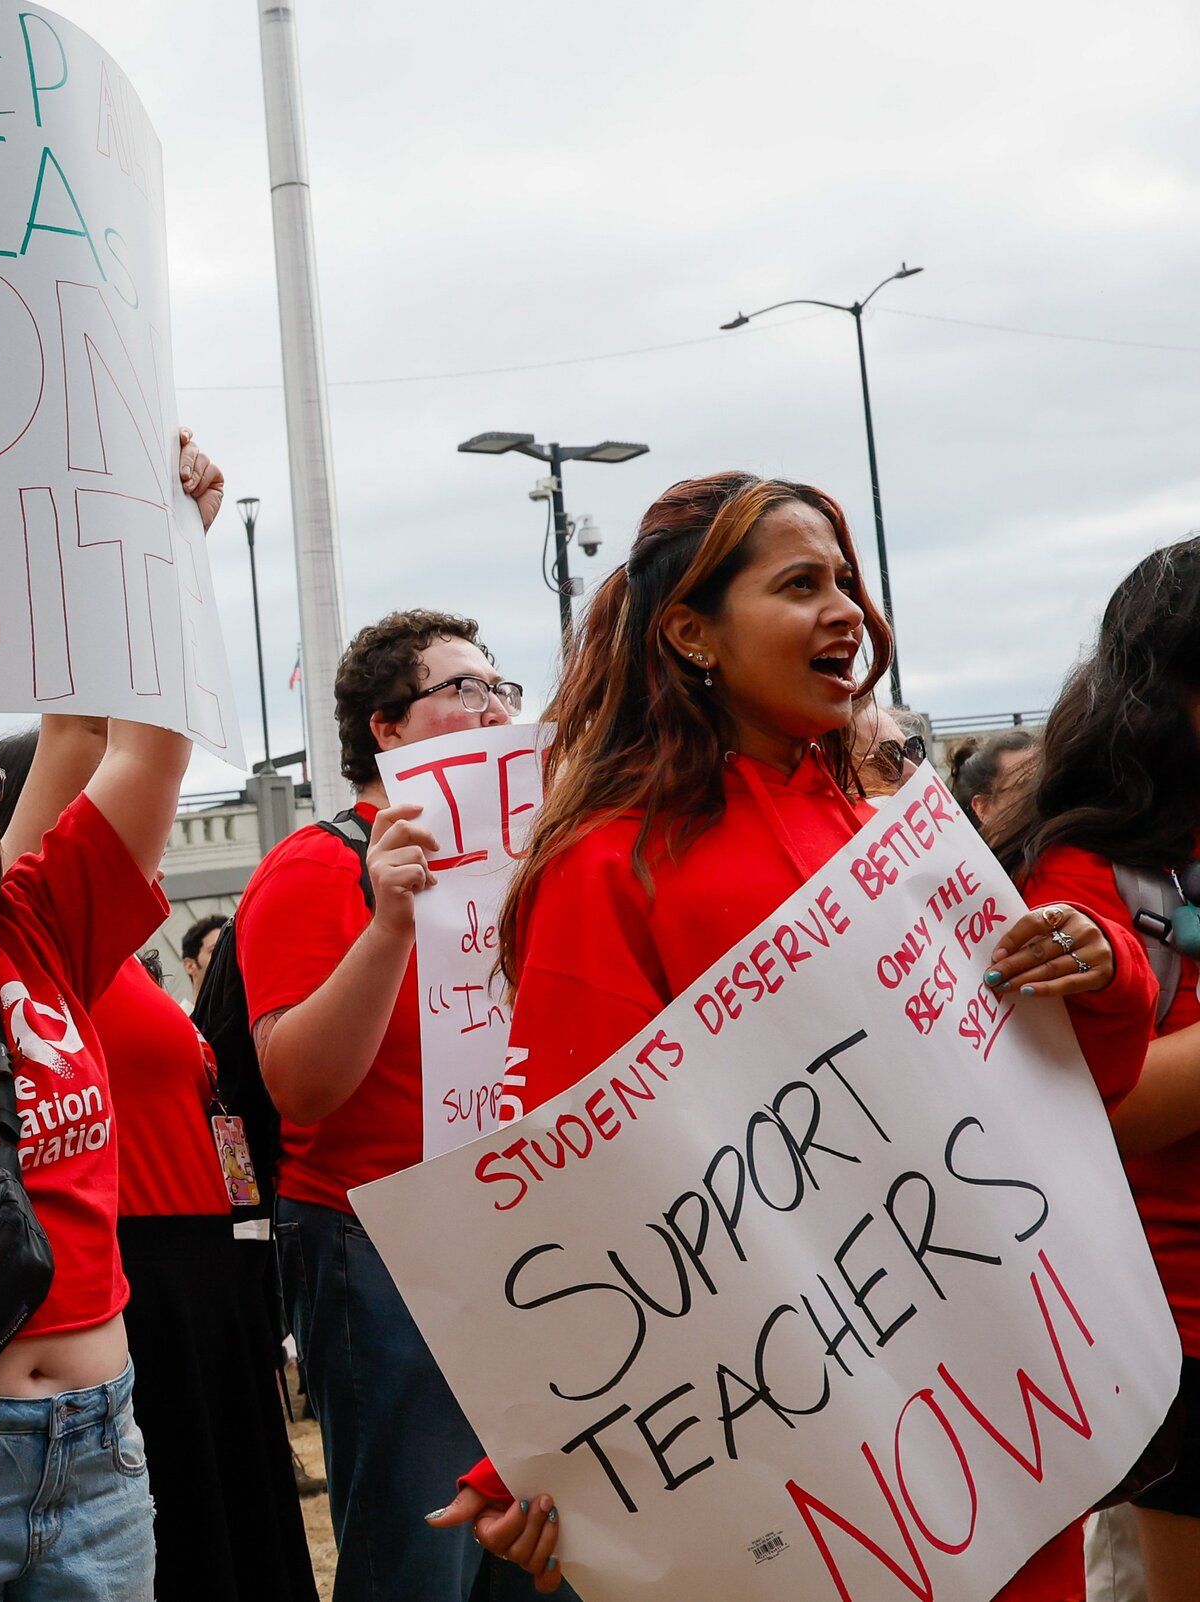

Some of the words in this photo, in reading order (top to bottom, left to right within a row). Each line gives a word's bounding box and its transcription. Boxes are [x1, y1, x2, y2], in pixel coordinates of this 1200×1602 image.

[474, 1029, 684, 1211] STUDENTS
[694, 885, 852, 1035] DESERVE
[850, 775, 961, 900] BETTER!
[877, 916, 932, 989] ONLY
[926, 860, 982, 922] THE
[905, 946, 957, 1035] BEST
[955, 897, 1007, 960] FOR
[505, 1028, 892, 1401] SUPPORT
[561, 1116, 1050, 1514] TEACHERS
[785, 1249, 1120, 1602] NOW!
